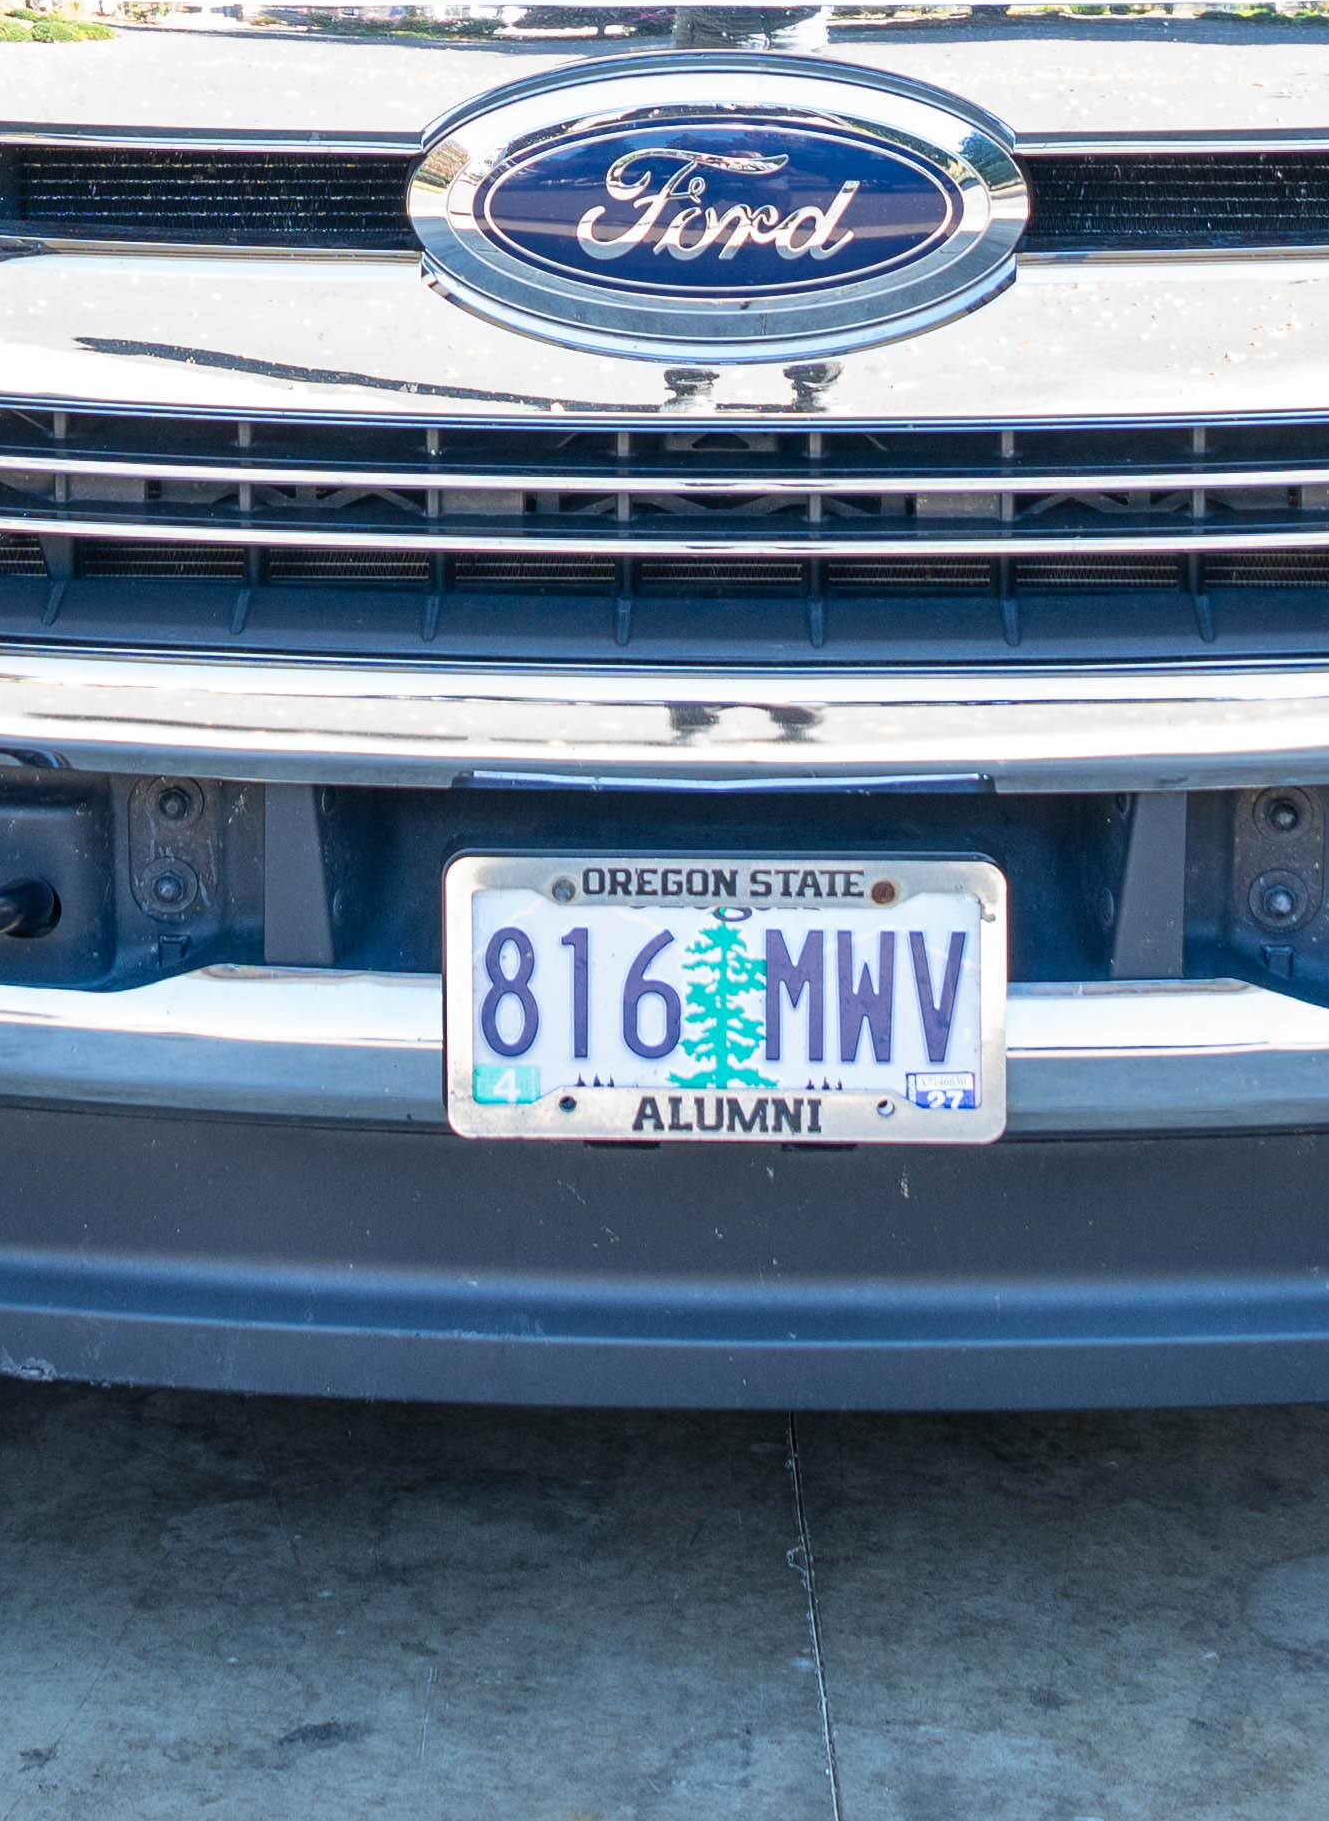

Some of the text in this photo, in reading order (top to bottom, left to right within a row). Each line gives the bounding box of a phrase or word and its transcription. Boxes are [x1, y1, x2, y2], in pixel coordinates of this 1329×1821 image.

[577, 147, 860, 261] Ford
[581, 867, 866, 899] OREGON STATE
[480, 926, 967, 1063] 816 MWV
[492, 1069, 522, 1103] 4
[927, 1090, 964, 1109] 27
[632, 1096, 823, 1133] ALUMNI
